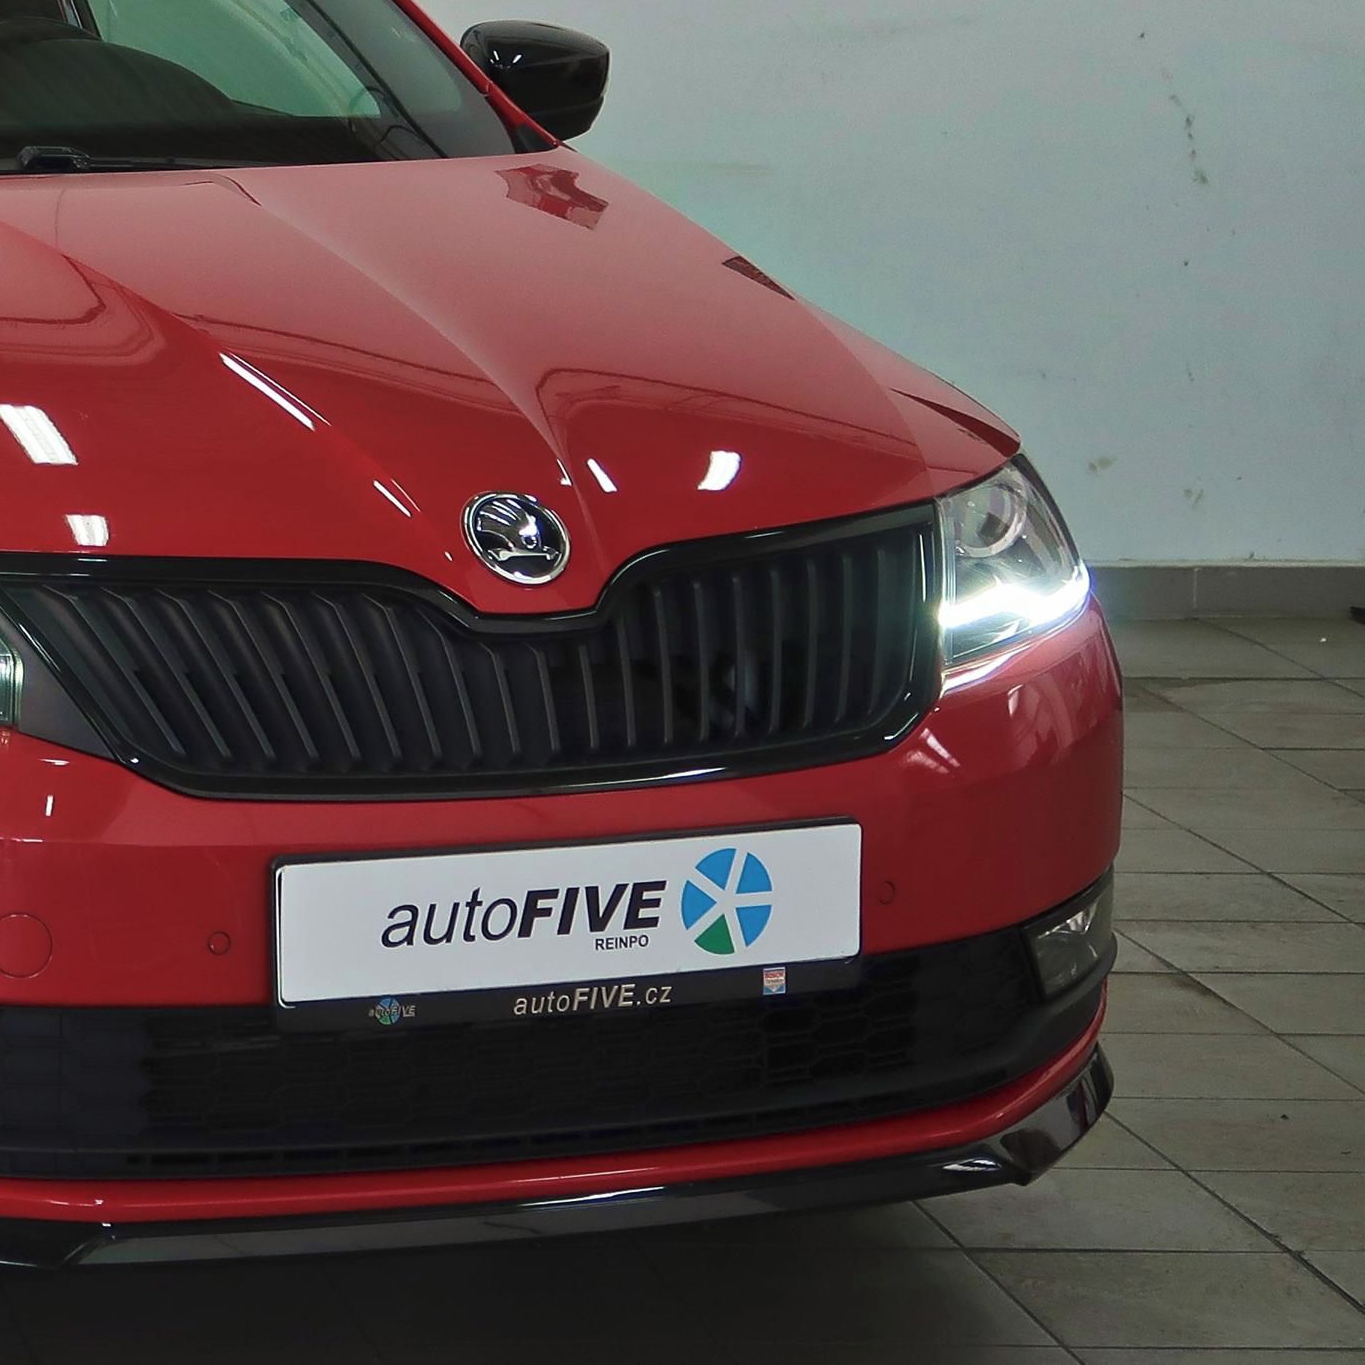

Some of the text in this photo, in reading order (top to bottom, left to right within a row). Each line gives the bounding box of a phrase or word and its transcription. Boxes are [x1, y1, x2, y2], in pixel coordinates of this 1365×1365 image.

[381, 880, 667, 948] autoFIVE
[595, 934, 649, 950] REINPO
[513, 984, 672, 1015] autoFIVE.cz
